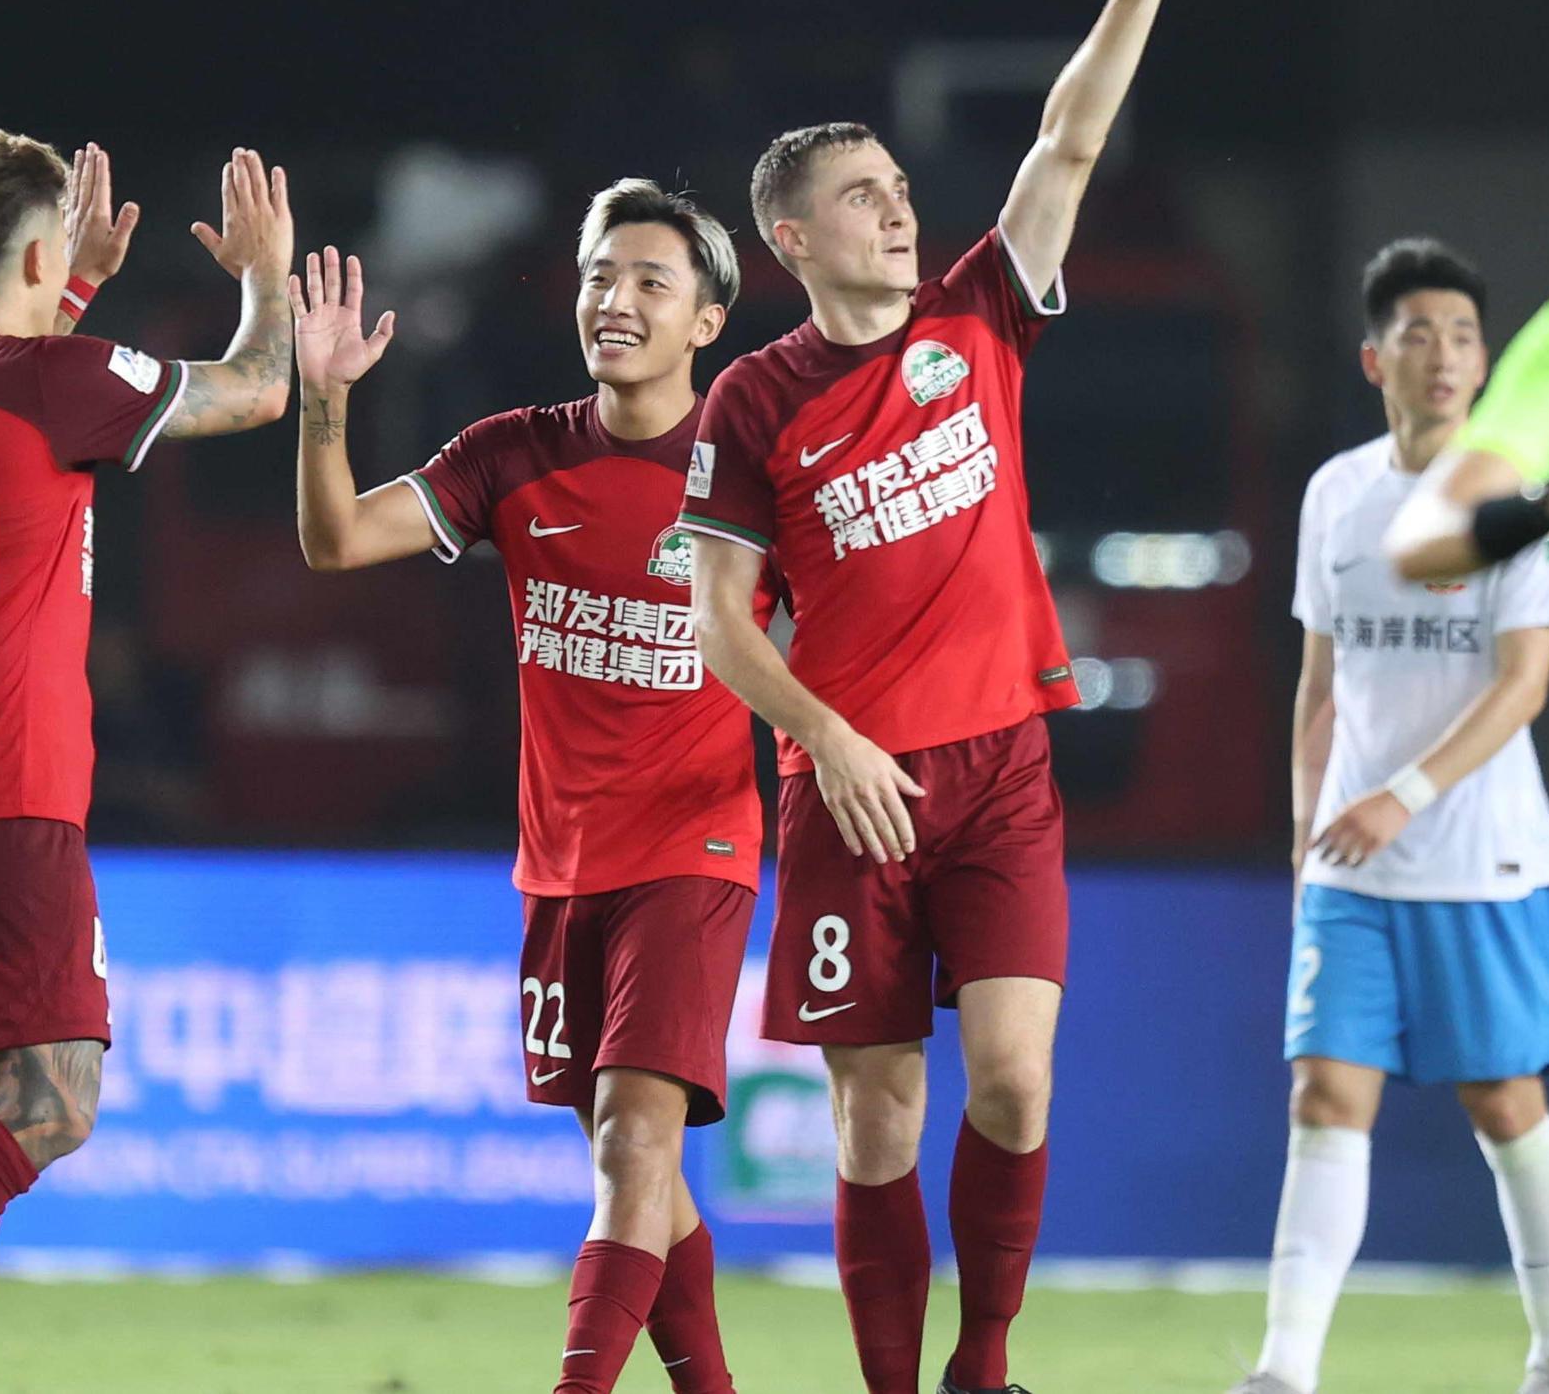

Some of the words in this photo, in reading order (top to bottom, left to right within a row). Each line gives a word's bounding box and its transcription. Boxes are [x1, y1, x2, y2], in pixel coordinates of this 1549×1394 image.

[814, 402, 989, 526] 郑发集团
[829, 445, 998, 560] 豫健集团
[654, 560, 692, 577] HENA
[524, 578, 696, 647] 郑发集团
[519, 622, 704, 691] 豫健集团
[808, 914, 850, 992] 8
[522, 977, 572, 1059] 22
